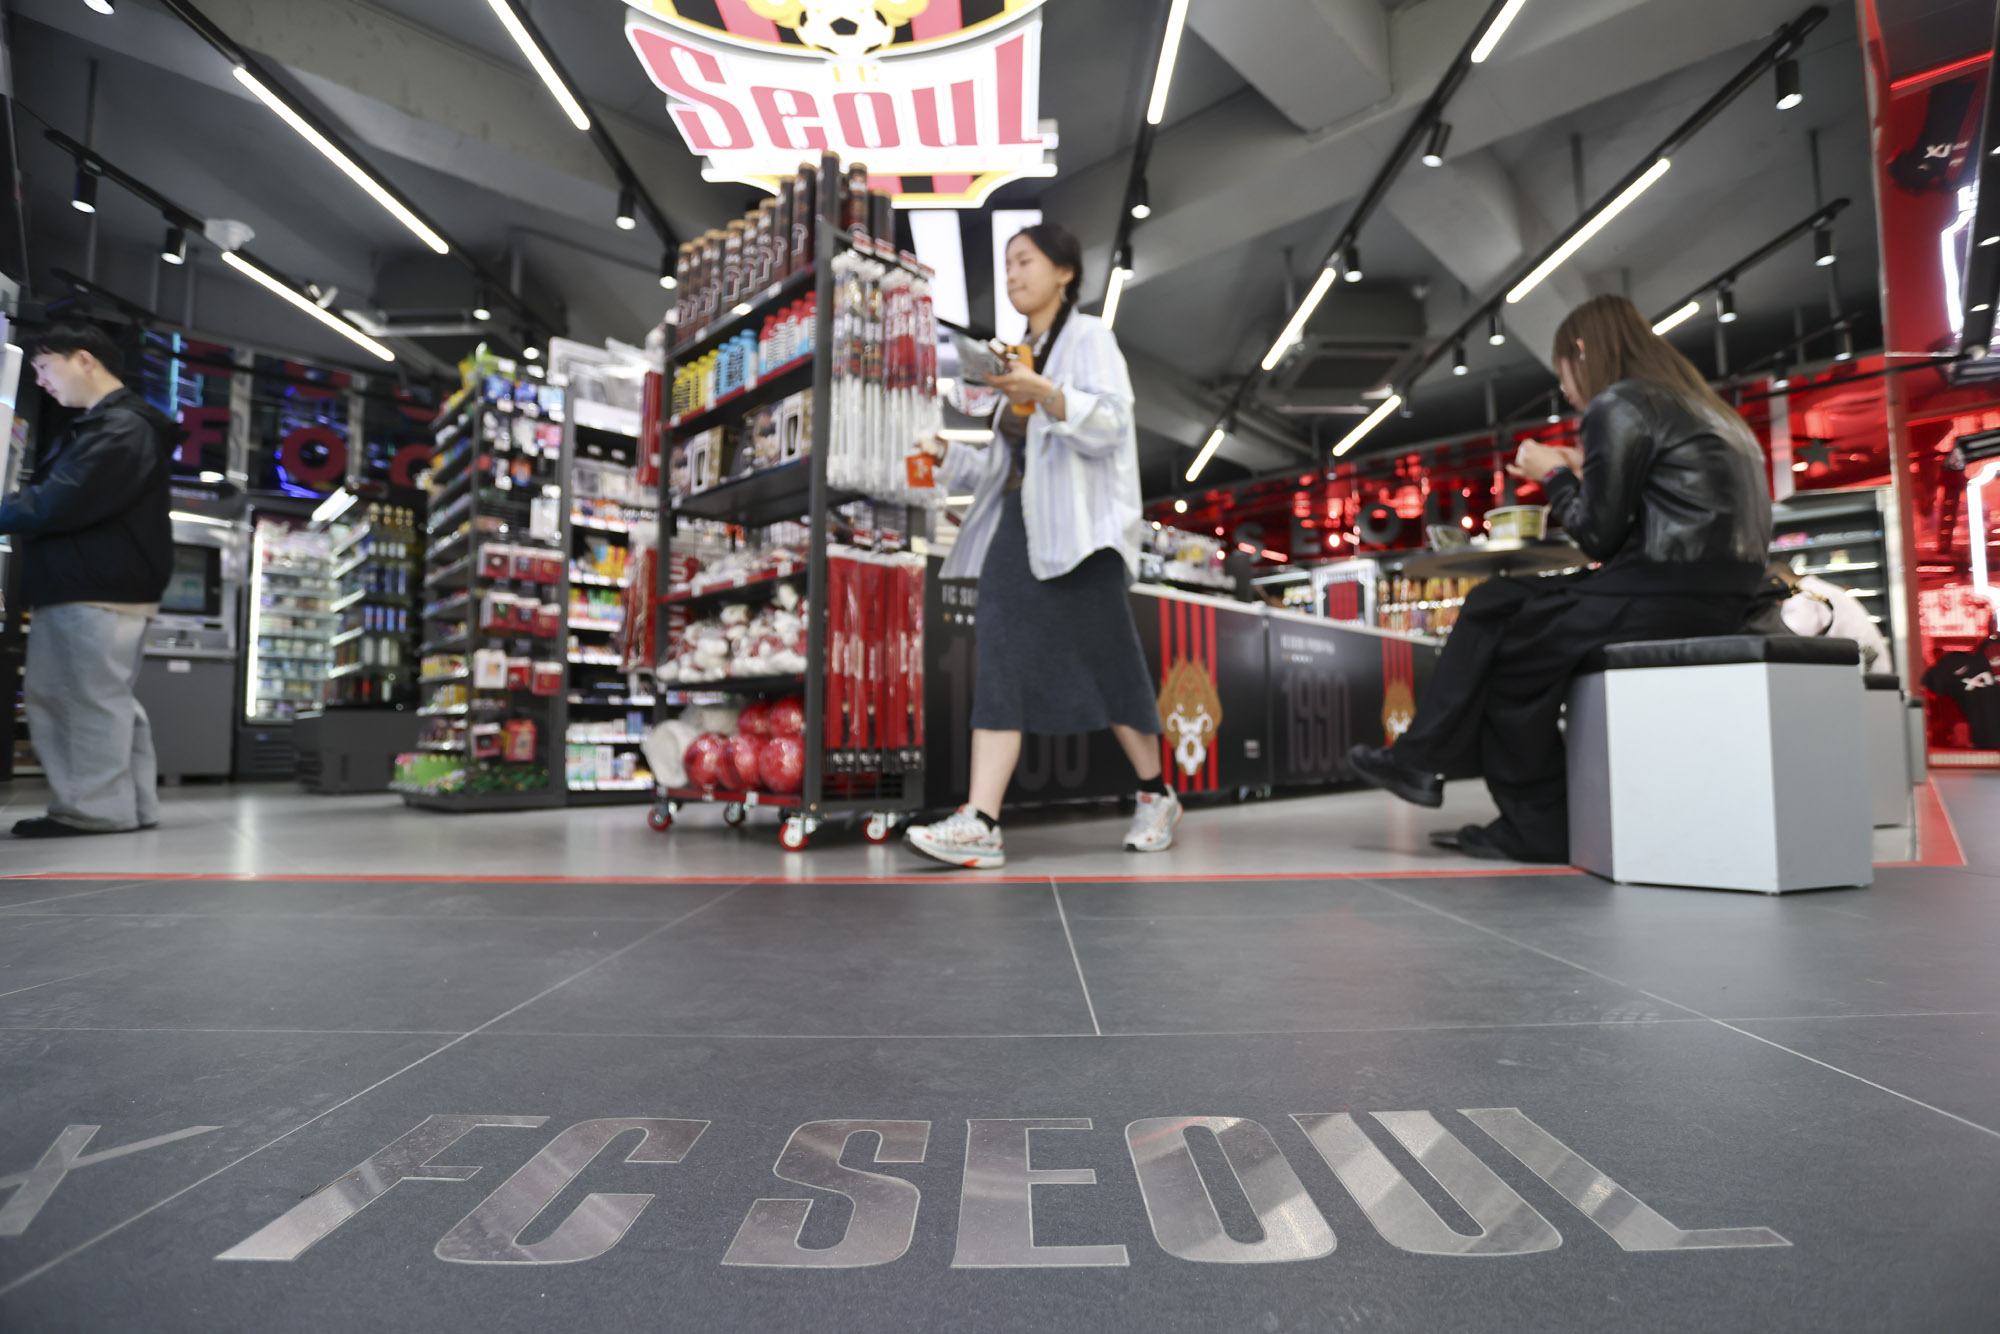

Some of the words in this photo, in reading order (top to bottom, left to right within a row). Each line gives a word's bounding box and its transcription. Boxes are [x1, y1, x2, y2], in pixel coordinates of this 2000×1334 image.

[633, 29, 1043, 150] Seoul
[213, 1114, 711, 1267] FC
[719, 1107, 1794, 1272] SEOUL
